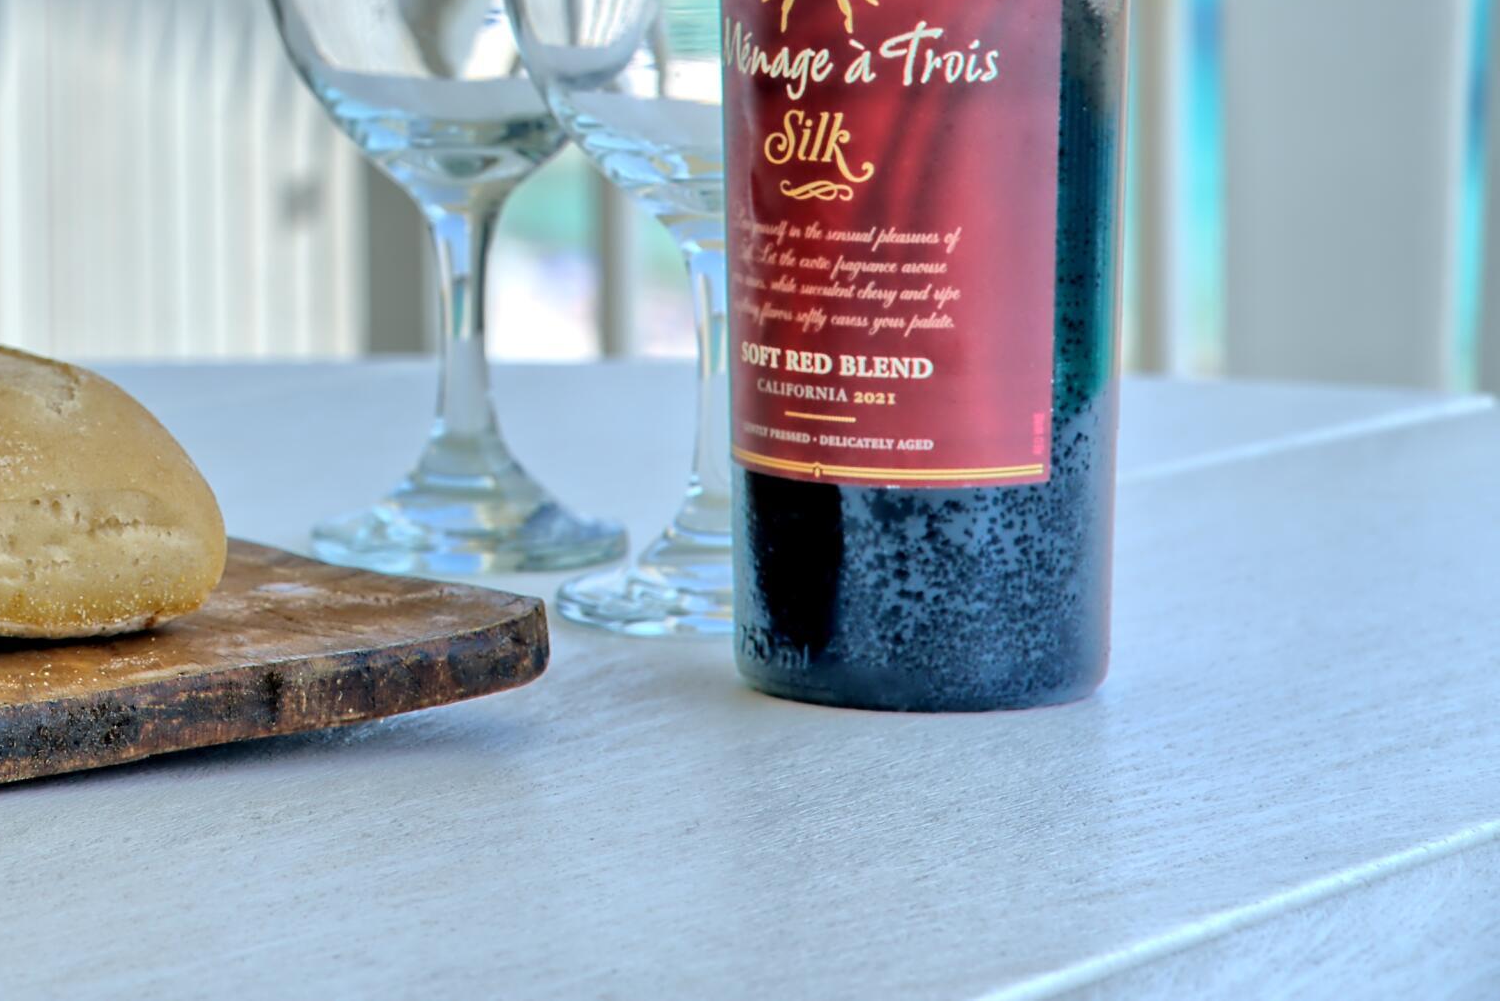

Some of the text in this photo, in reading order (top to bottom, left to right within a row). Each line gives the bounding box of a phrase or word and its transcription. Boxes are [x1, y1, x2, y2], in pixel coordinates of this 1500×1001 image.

[724, 16, 999, 100] Ménage à Trois
[763, 109, 875, 183] Silk
[788, 225, 801, 238] in
[804, 221, 822, 239] the
[825, 226, 877, 243] sensual
[871, 226, 940, 252] pleasures
[943, 226, 962, 254] of
[779, 248, 797, 267] the
[829, 255, 898, 281] fragrance
[901, 262, 948, 274] arouse
[800, 281, 855, 299] succulent
[857, 280, 898, 309] cherry
[899, 283, 933, 300] and
[933, 286, 961, 310] ripe
[830, 314, 870, 327] caress
[868, 316, 906, 336] your
[903, 311, 955, 338] palate.
[741, 340, 934, 379] SOFT RED BLEND
[757, 377, 896, 405] CALIFORNIA 2021
[769, 428, 811, 444] PRESSED
[819, 433, 894, 450] DELICATELY
[897, 438, 934, 451] AGED
